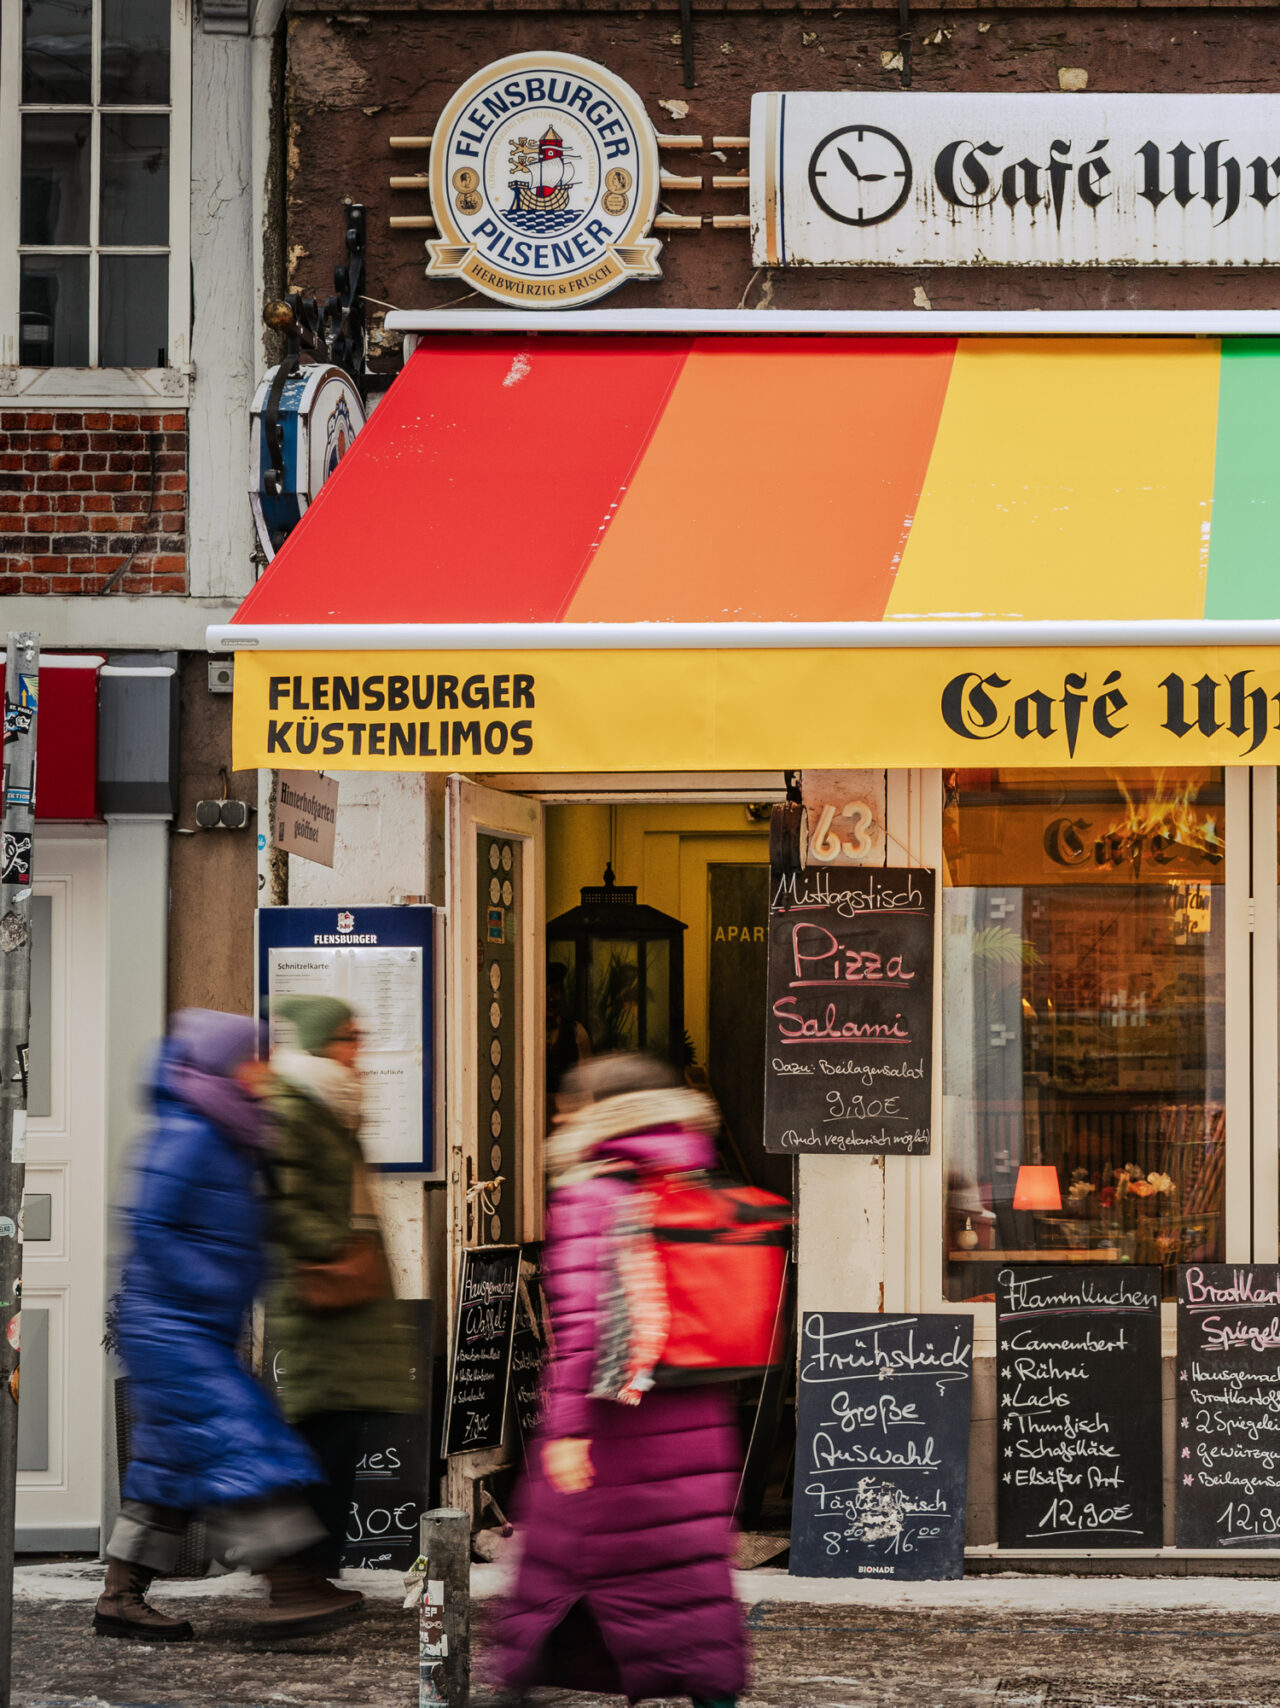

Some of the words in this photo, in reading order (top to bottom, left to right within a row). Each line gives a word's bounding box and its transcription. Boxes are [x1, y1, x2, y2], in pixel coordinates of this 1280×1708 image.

[455, 77, 630, 160] FLENSBURGER
[934, 138, 1112, 231] Café
[471, 217, 613, 269] PILSENER
[472, 264, 556, 295] HERBWÜRZIG
[559, 284, 566, 293] &
[569, 264, 611, 291] FRISCH
[268, 674, 535, 711] FLENSBURGER
[941, 670, 1129, 759] Café
[267, 716, 533, 756] KÜSTENLIMOS
[811, 801, 873, 862] 63
[772, 872, 923, 918] Mittagstisch
[314, 934, 378, 945] FLENSBURGER
[715, 926, 769, 942] APAR
[277, 962, 330, 971] Schnitzelkarte
[792, 922, 915, 980] Pizza
[772, 995, 909, 1038] Salami
[772, 1058, 816, 1074] Dazu:
[818, 1058, 924, 1087] Beilagensalat
[826, 1091, 901, 1119] 9,90€
[781, 1128, 821, 1147] (Auch
[824, 1128, 891, 1150] vegetarisch
[803, 1314, 972, 1371] Frühstück
[1011, 1329, 1128, 1352] Camembert
[1014, 1357, 1089, 1381] Rührei
[1012, 1383, 1071, 1408] Lachs
[831, 1391, 919, 1433] Große
[1008, 1409, 1109, 1438] Thunfisch
[1196, 1409, 1214, 1434] 2
[813, 1432, 942, 1468] Auswahl
[1088, 1465, 1125, 1488] Art
[1039, 1498, 1133, 1529] 12,90€
[858, 1565, 895, 1574] BIONADE
